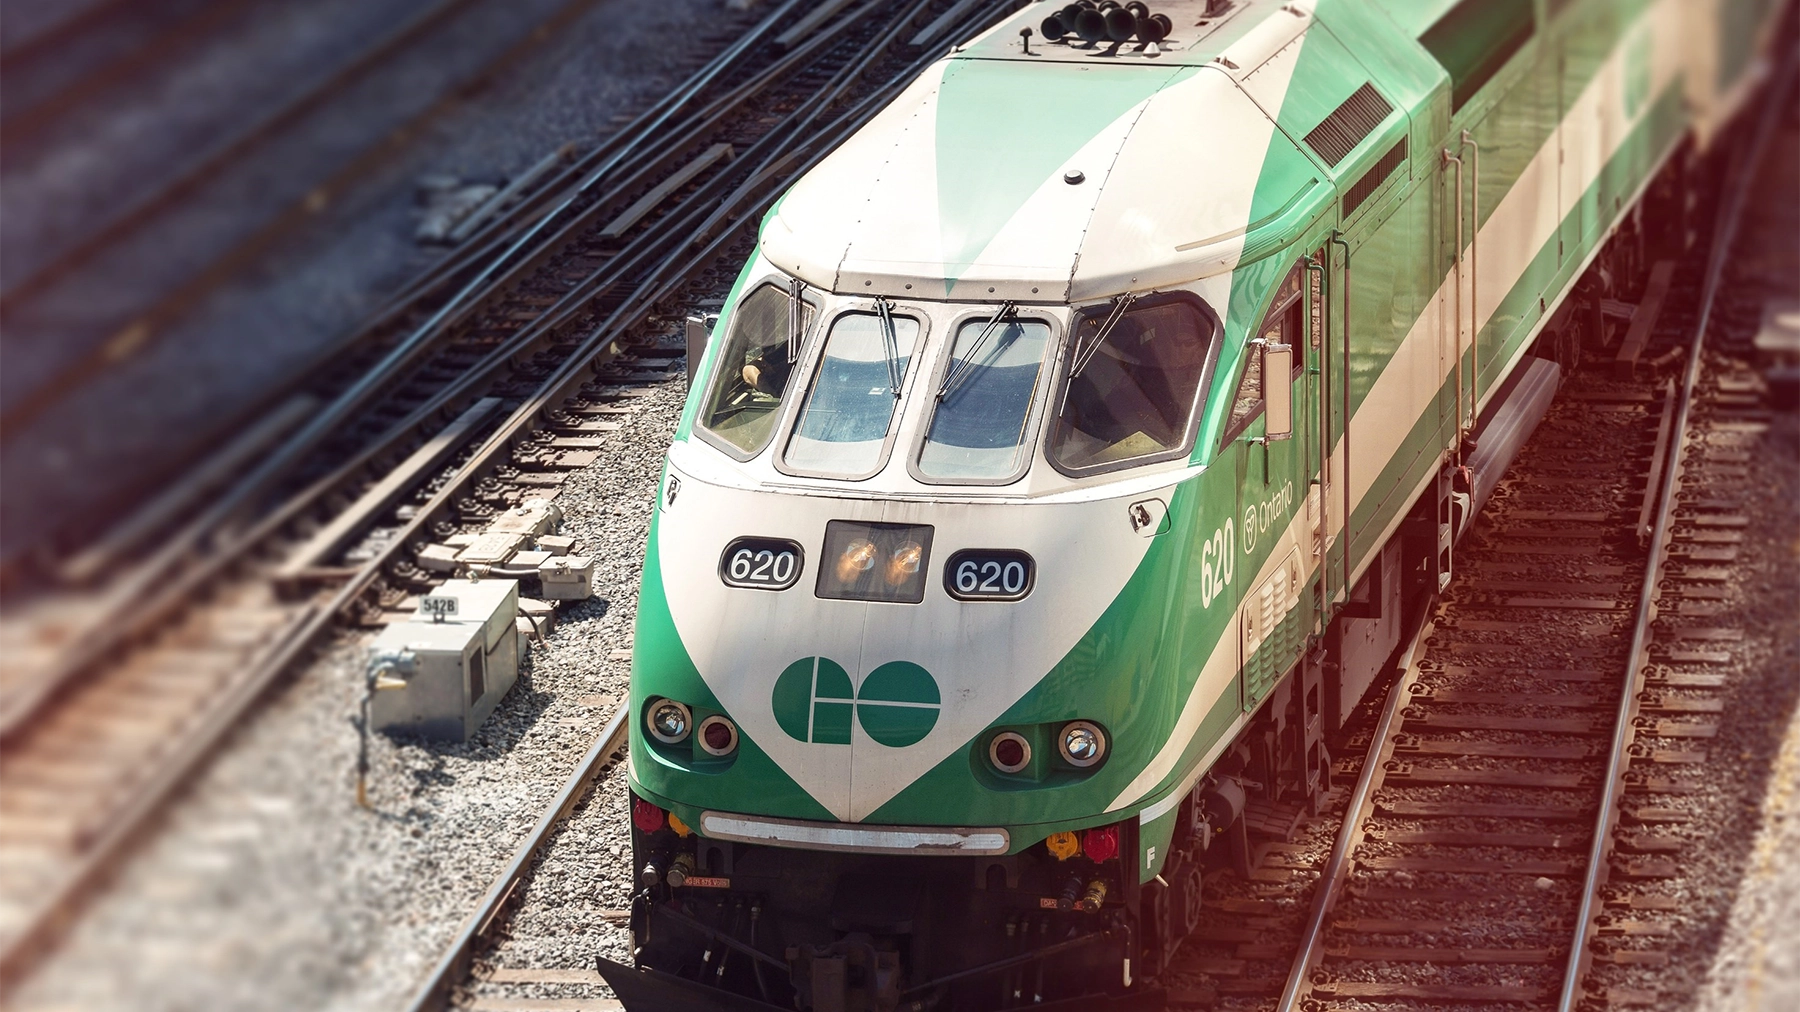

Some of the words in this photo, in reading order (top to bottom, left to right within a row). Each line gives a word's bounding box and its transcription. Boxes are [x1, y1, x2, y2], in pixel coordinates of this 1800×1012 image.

[1259, 478, 1293, 534] Ontario
[730, 548, 794, 583] 620
[955, 561, 1025, 593] 620
[1201, 516, 1235, 609] 620
[423, 599, 455, 612] 542B
[772, 656, 942, 748] GO
[1146, 846, 1155, 869] F
